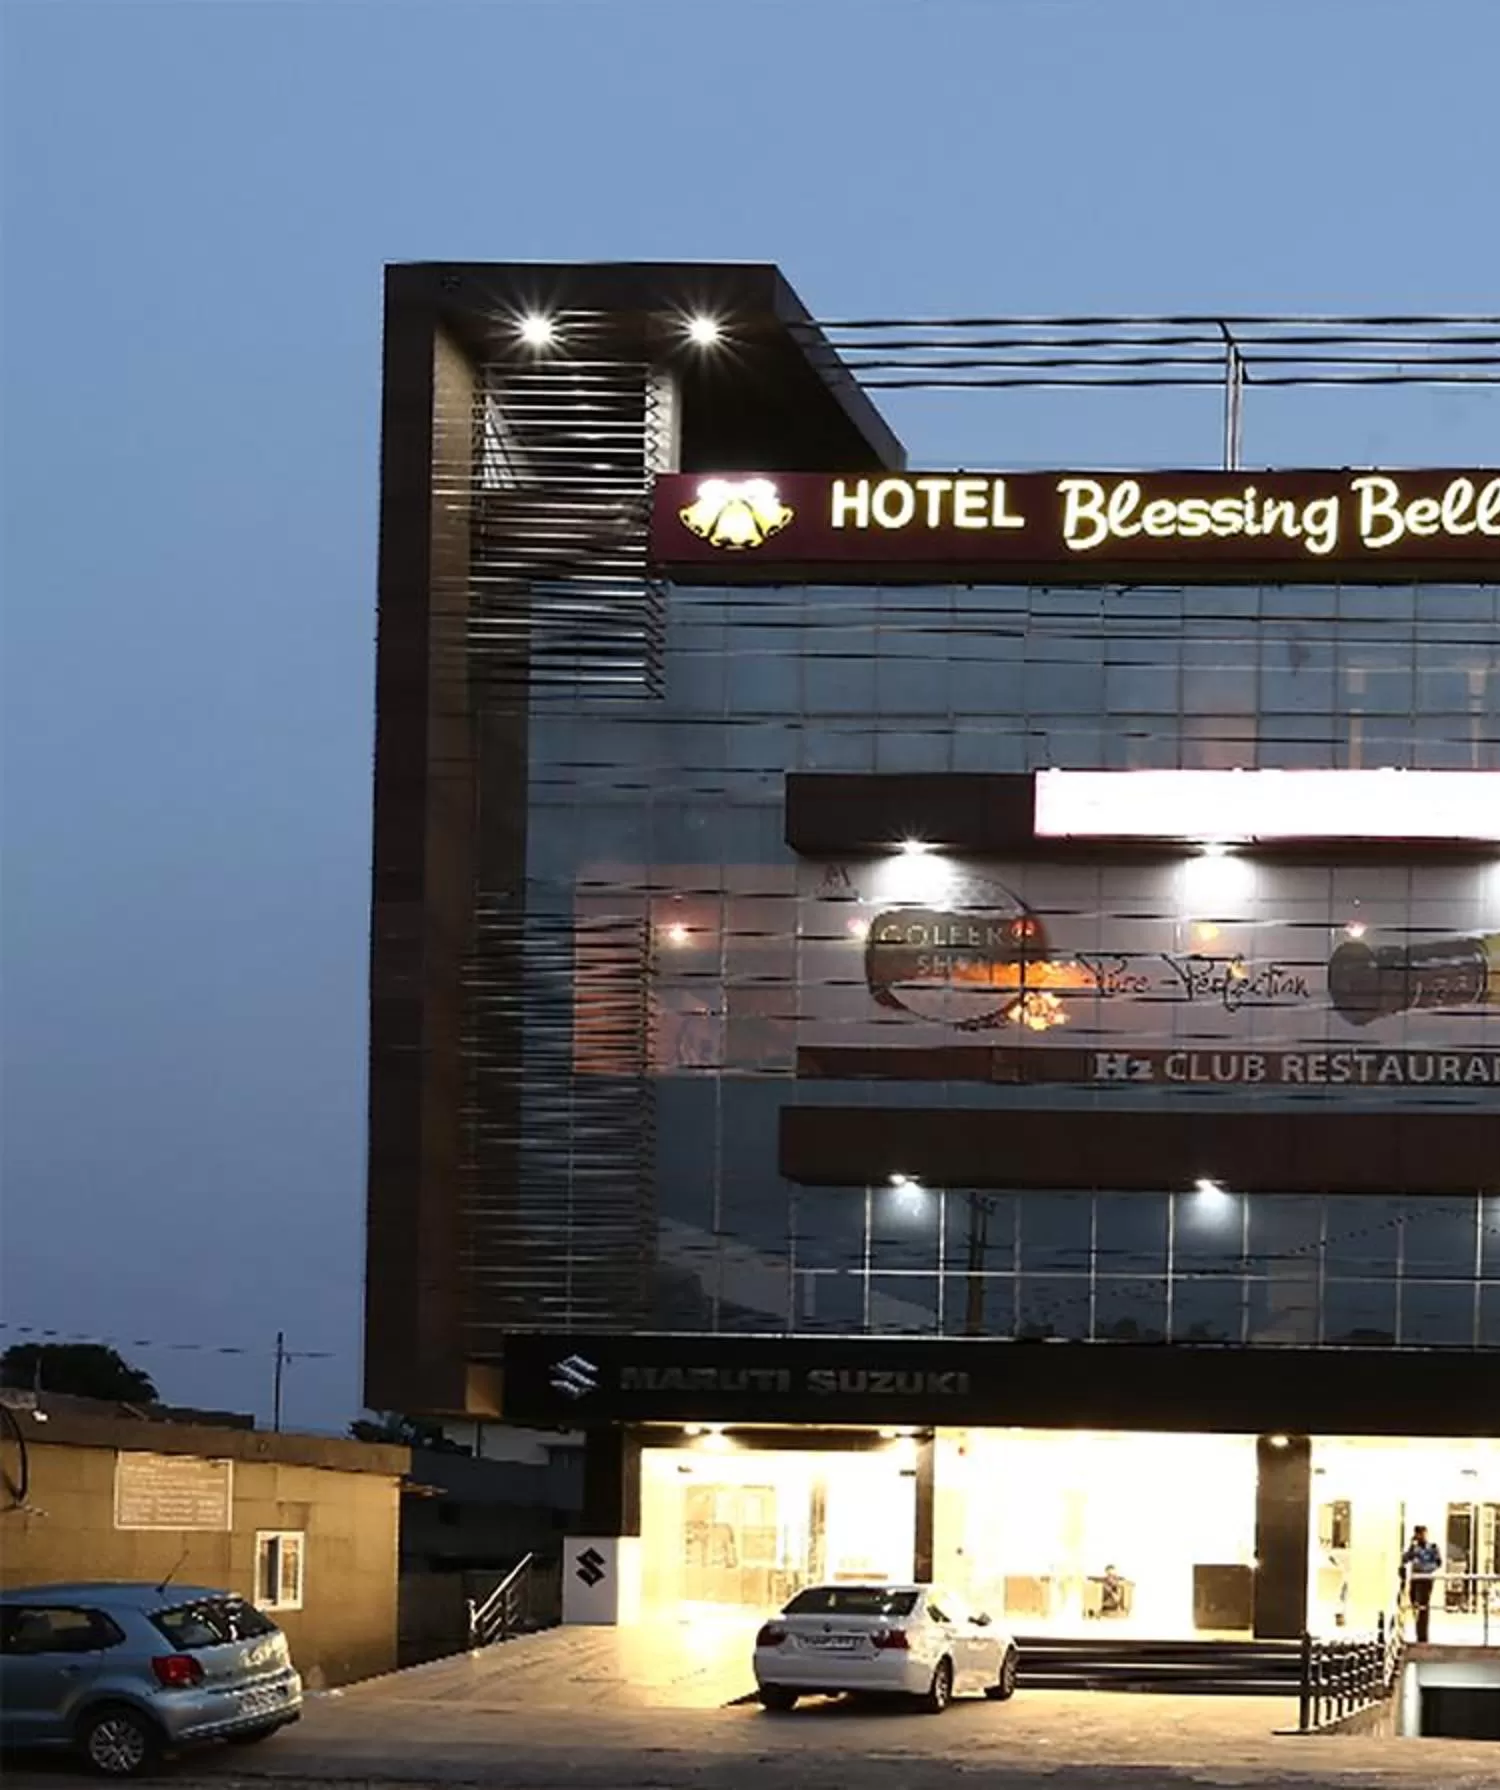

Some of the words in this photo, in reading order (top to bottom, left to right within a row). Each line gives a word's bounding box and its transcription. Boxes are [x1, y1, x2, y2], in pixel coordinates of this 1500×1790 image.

[831, 478, 1025, 529] HOTEL
[1056, 478, 1340, 555] Blessing
[1076, 951, 1150, 998] Pure
[1164, 1053, 1265, 1082] CLUB
[620, 1367, 791, 1391] MARUTI
[806, 1369, 971, 1394] SUZUKI
